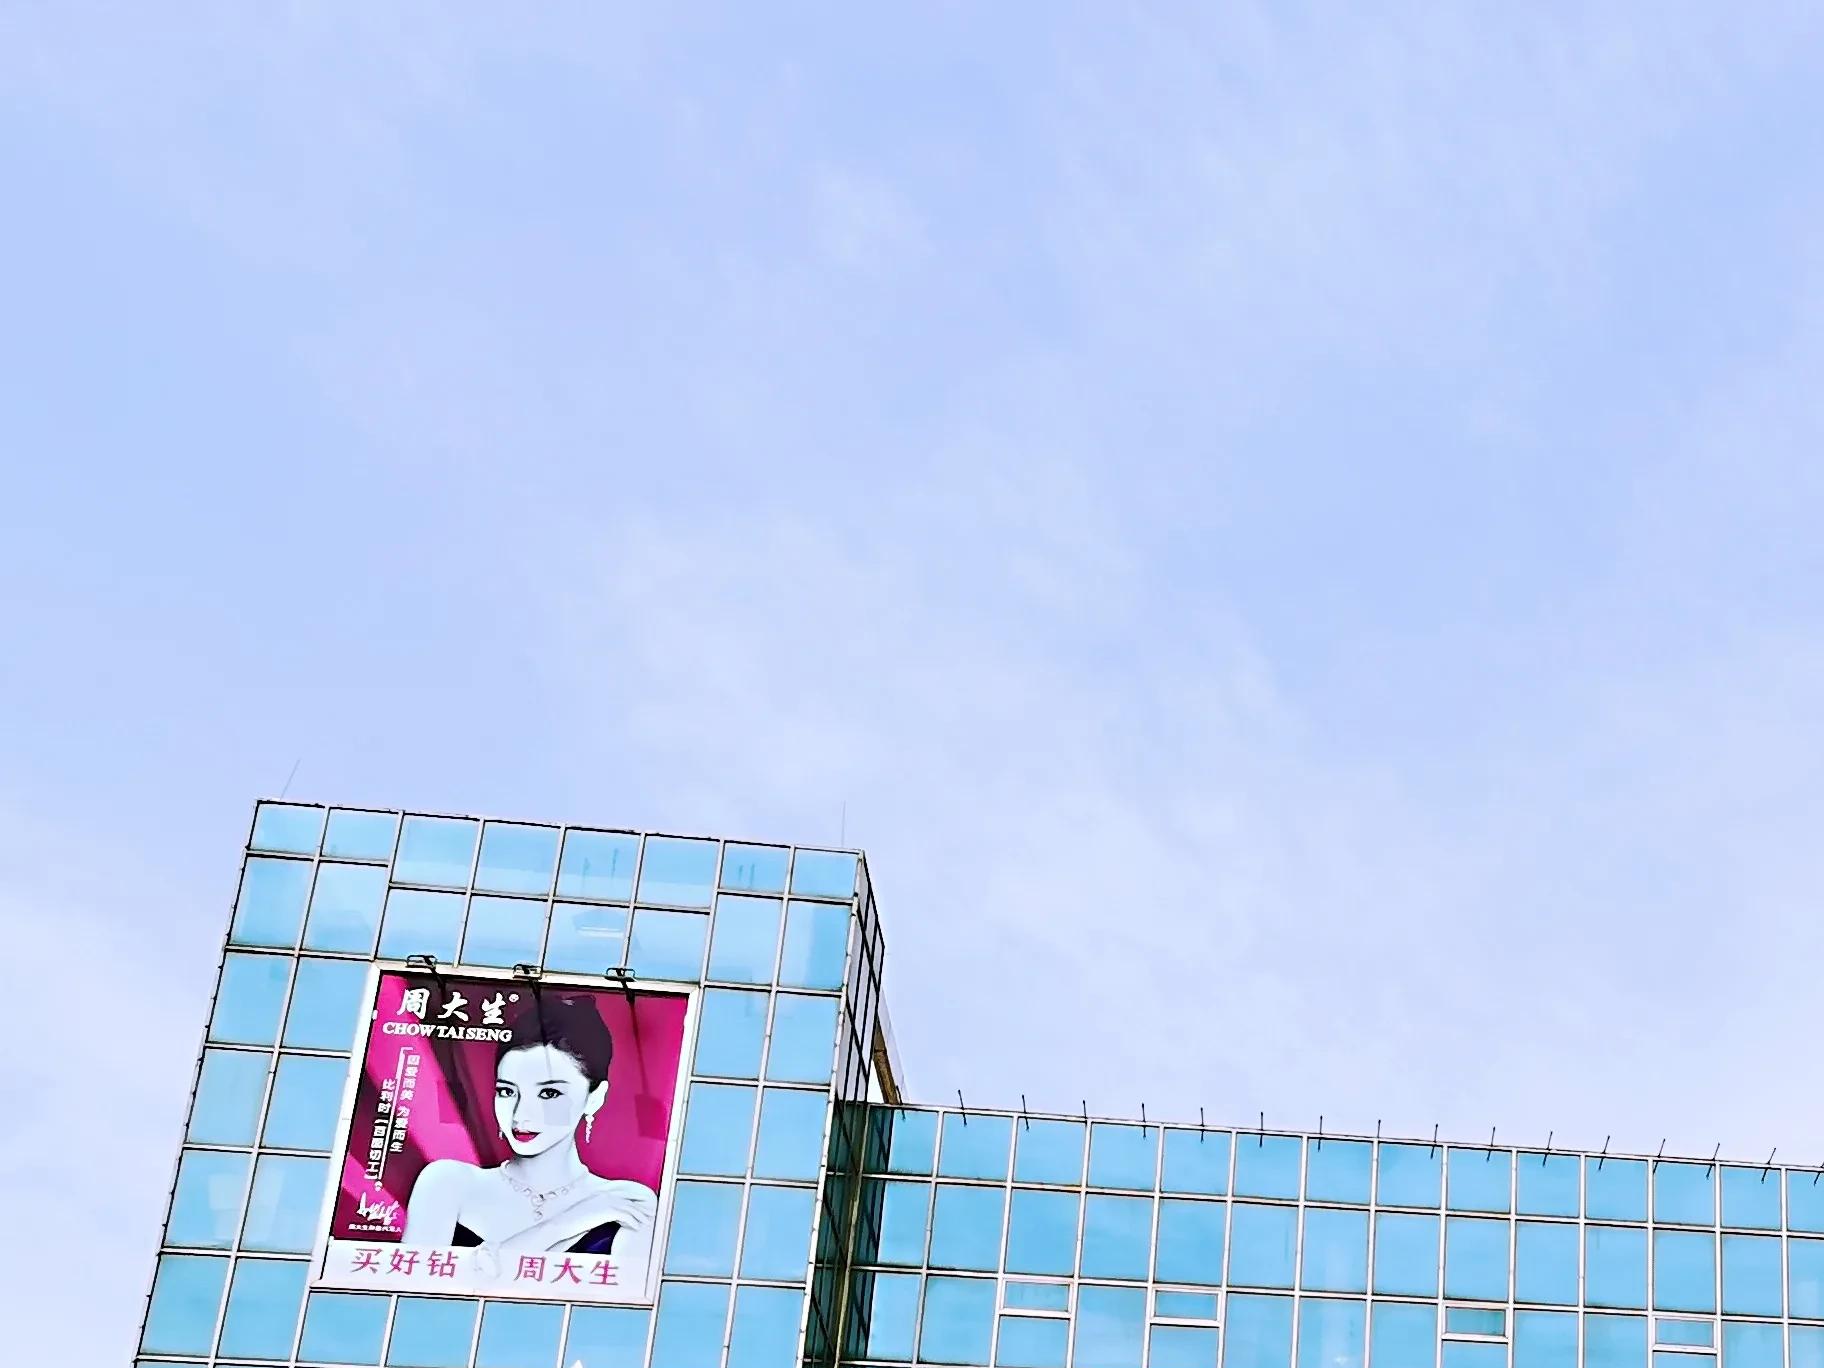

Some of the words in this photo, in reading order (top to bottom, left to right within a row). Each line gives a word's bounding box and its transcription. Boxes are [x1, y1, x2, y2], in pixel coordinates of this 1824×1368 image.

[397, 988, 507, 1025] 周大生
[351, 1248, 459, 1279] 买好钻
[513, 1255, 619, 1286] 周大生
